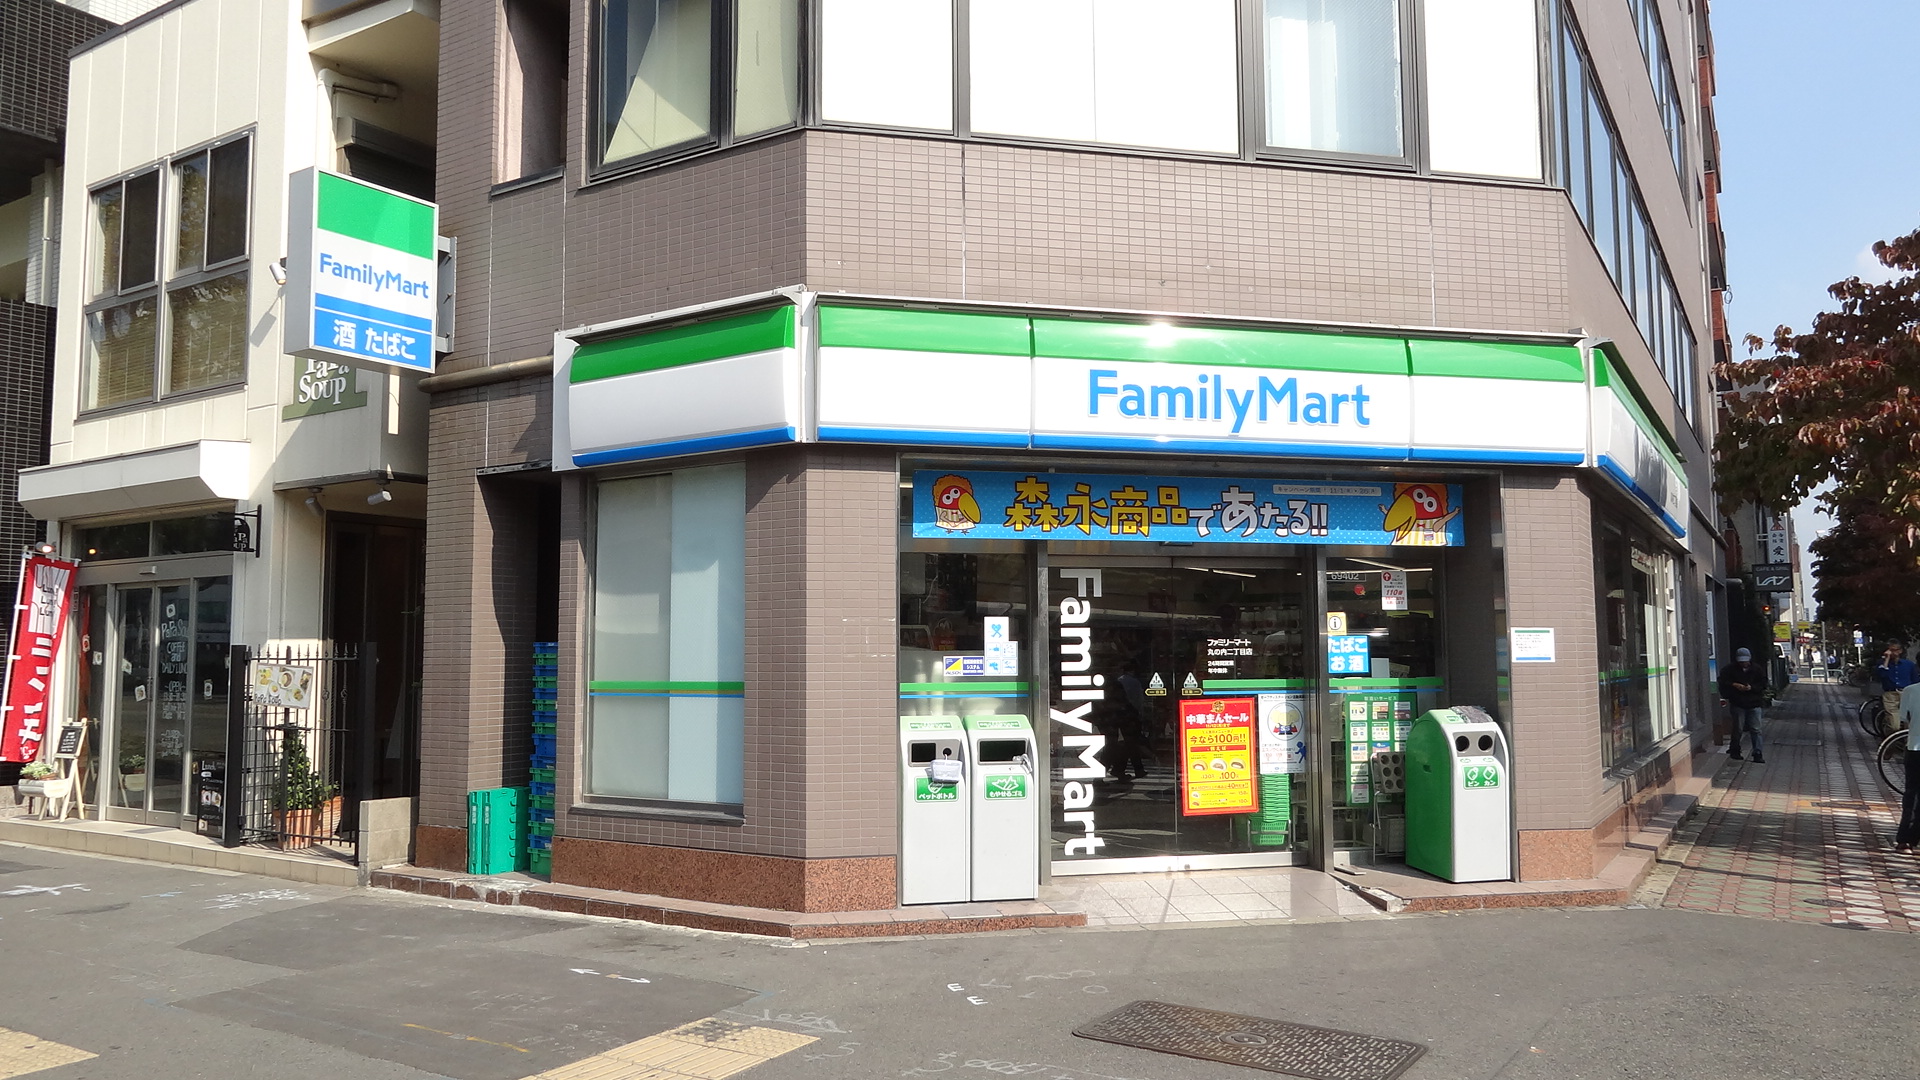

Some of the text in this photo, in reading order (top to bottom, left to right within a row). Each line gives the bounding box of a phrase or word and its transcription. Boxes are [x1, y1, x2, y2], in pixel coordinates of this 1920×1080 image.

[319, 252, 430, 299] FamilyMart
[333, 318, 417, 361] 酒 たばこ
[1088, 368, 1371, 434] FamilyMart
[1331, 572, 1360, 580] 69402
[1207, 638, 1251, 647] ファミリーマート
[1327, 637, 1368, 653] たばこ
[1207, 647, 1253, 656] 丸の内二丁目店
[1330, 655, 1364, 671] お酒
[1050, 568, 1107, 856] FamilyMart
[1185, 713, 1249, 725] 中華まんセール
